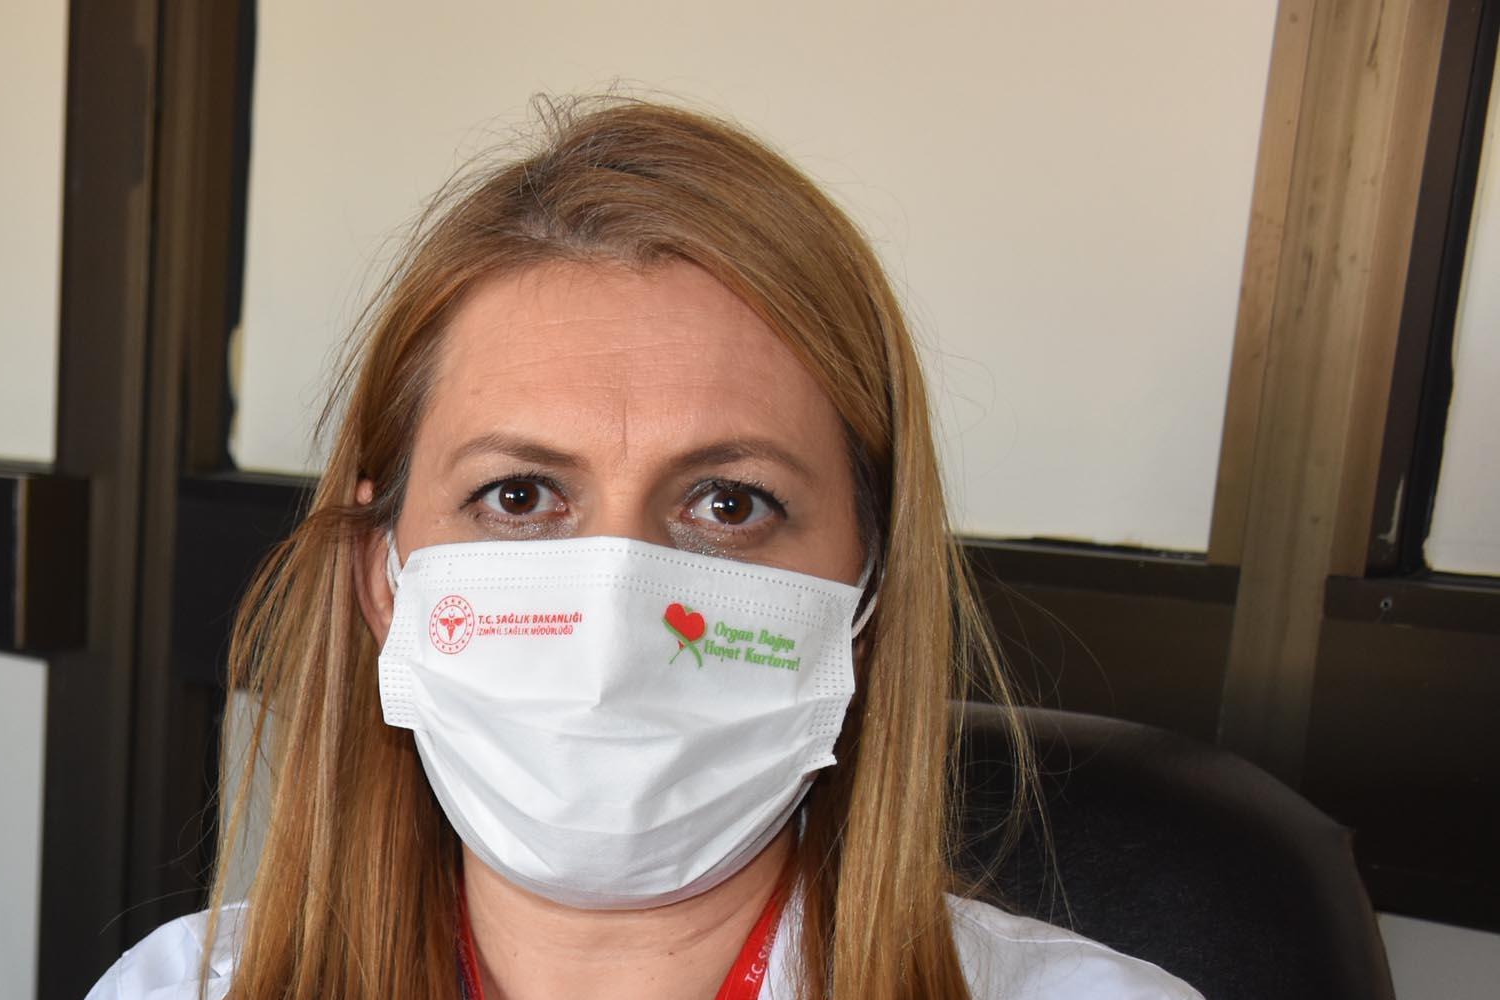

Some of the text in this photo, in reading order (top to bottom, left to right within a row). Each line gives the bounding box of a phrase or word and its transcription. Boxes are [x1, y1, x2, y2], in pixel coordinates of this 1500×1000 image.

[496, 613, 531, 625] SAĞLIK
[532, 611, 583, 624] BAKANLIĞI
[714, 621, 754, 644] Organ
[704, 639, 741, 662] Hayat
